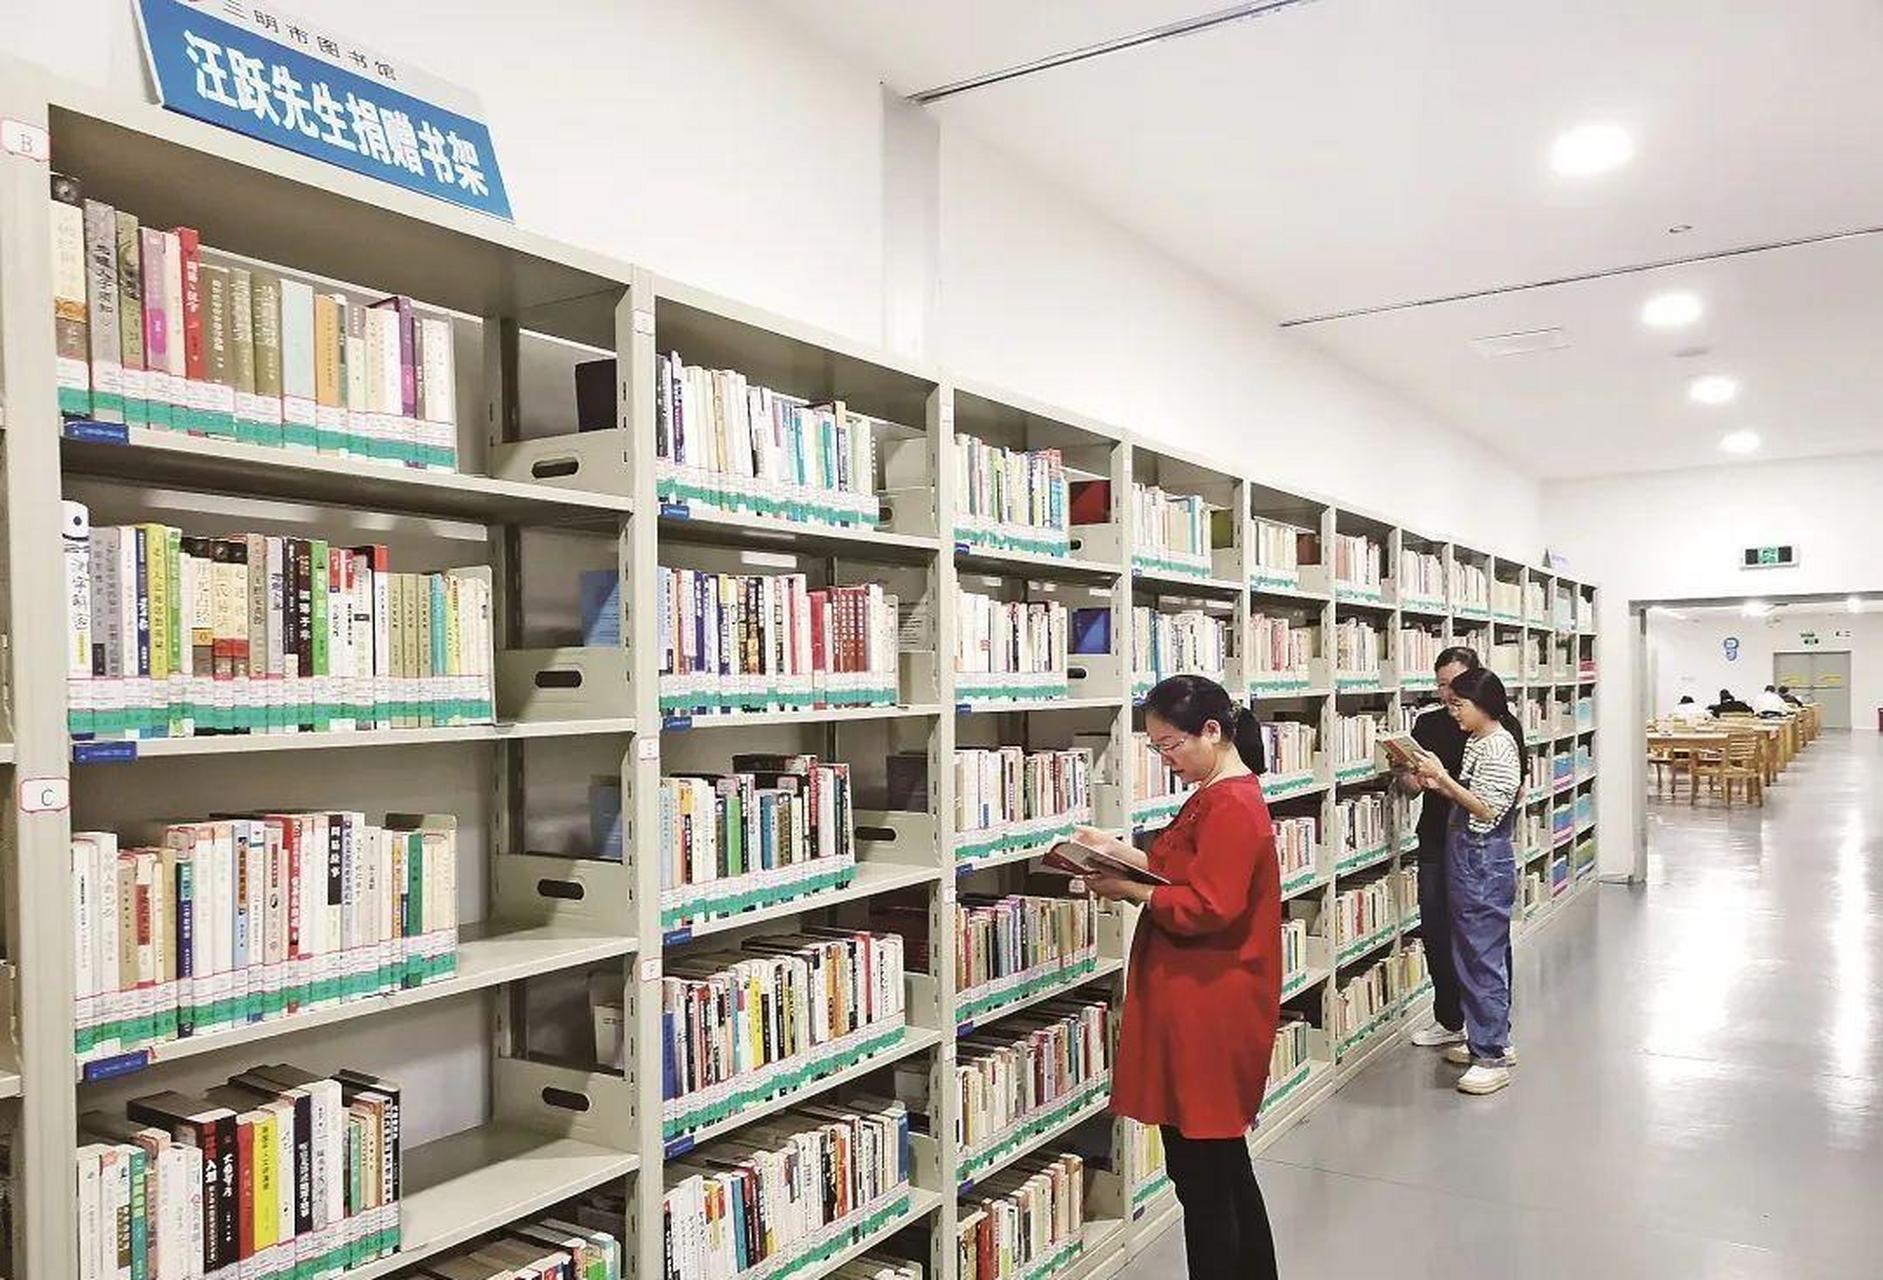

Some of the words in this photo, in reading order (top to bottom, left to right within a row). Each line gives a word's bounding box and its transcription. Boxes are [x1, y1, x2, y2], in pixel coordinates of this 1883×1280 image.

[223, 0, 397, 81] 三明市图书馆
[184, 29, 489, 197] 汪跃先生捐赠书架
[41, 787, 54, 807] C
